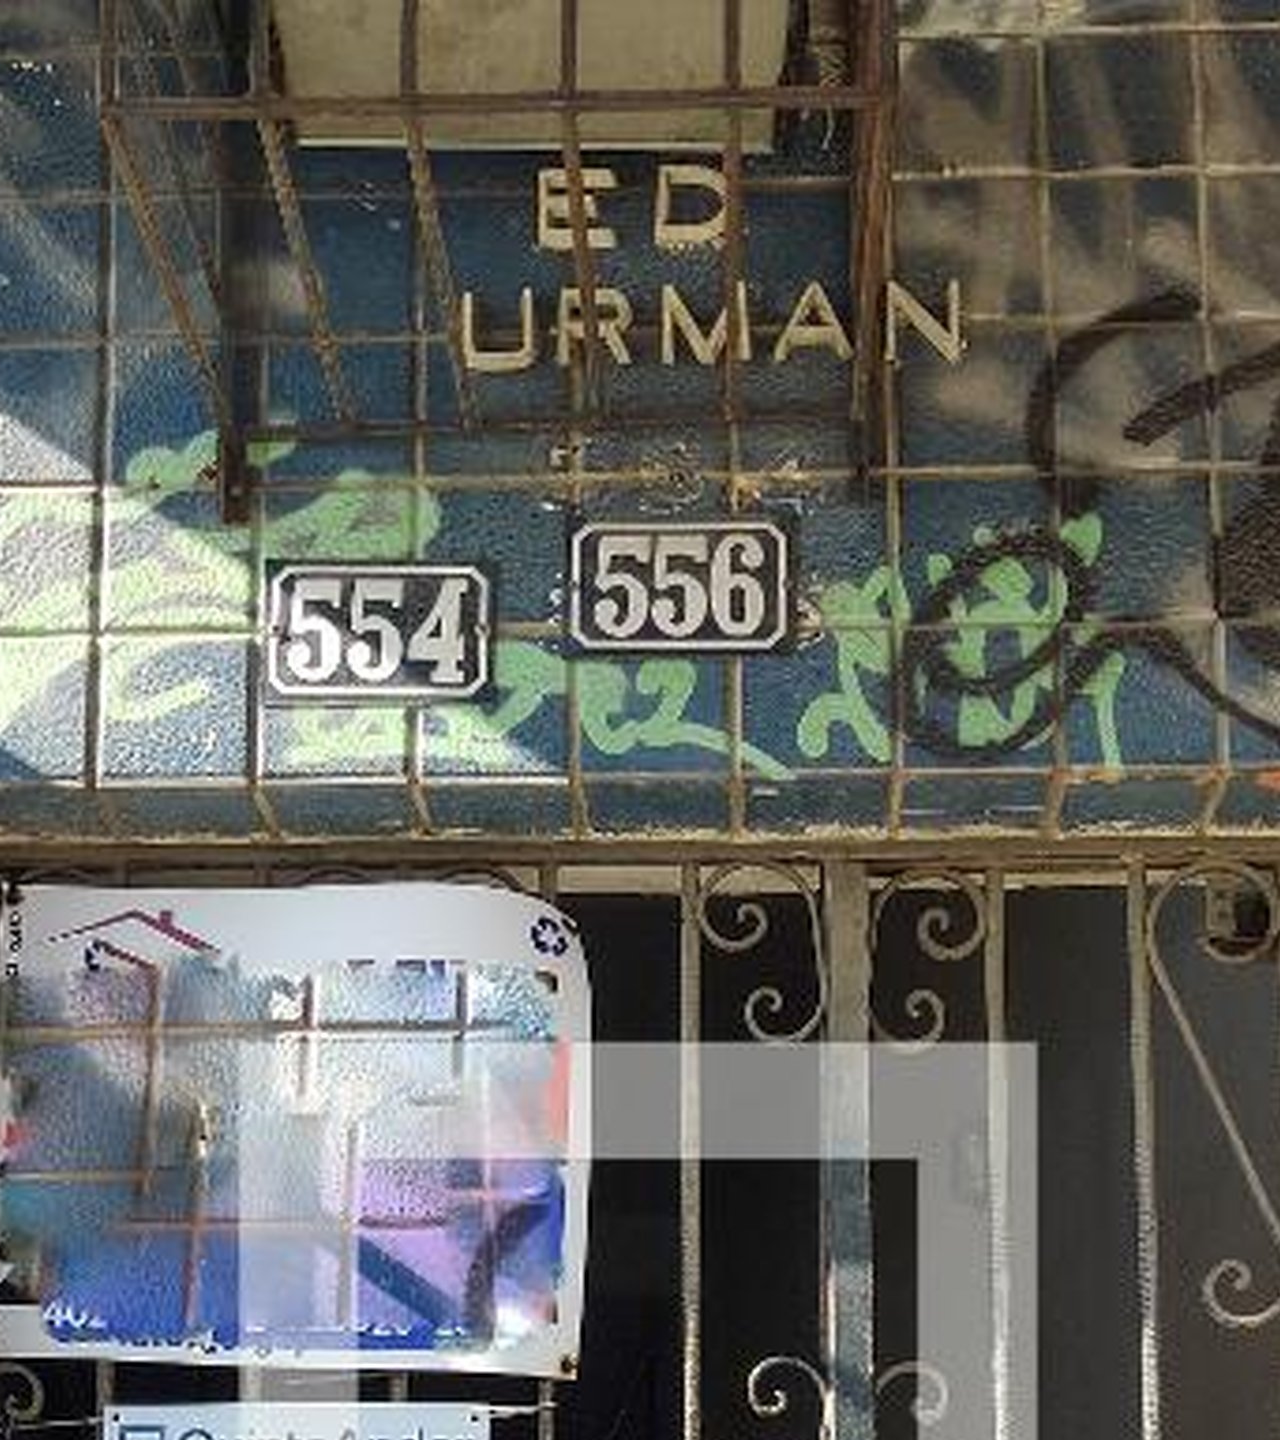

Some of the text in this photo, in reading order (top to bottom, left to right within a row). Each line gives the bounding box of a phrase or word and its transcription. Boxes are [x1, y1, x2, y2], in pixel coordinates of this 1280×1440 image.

[536, 165, 732, 251] ED
[460, 281, 964, 371] URMAN
[284, 567, 469, 685] 554
[593, 532, 766, 640] 556
